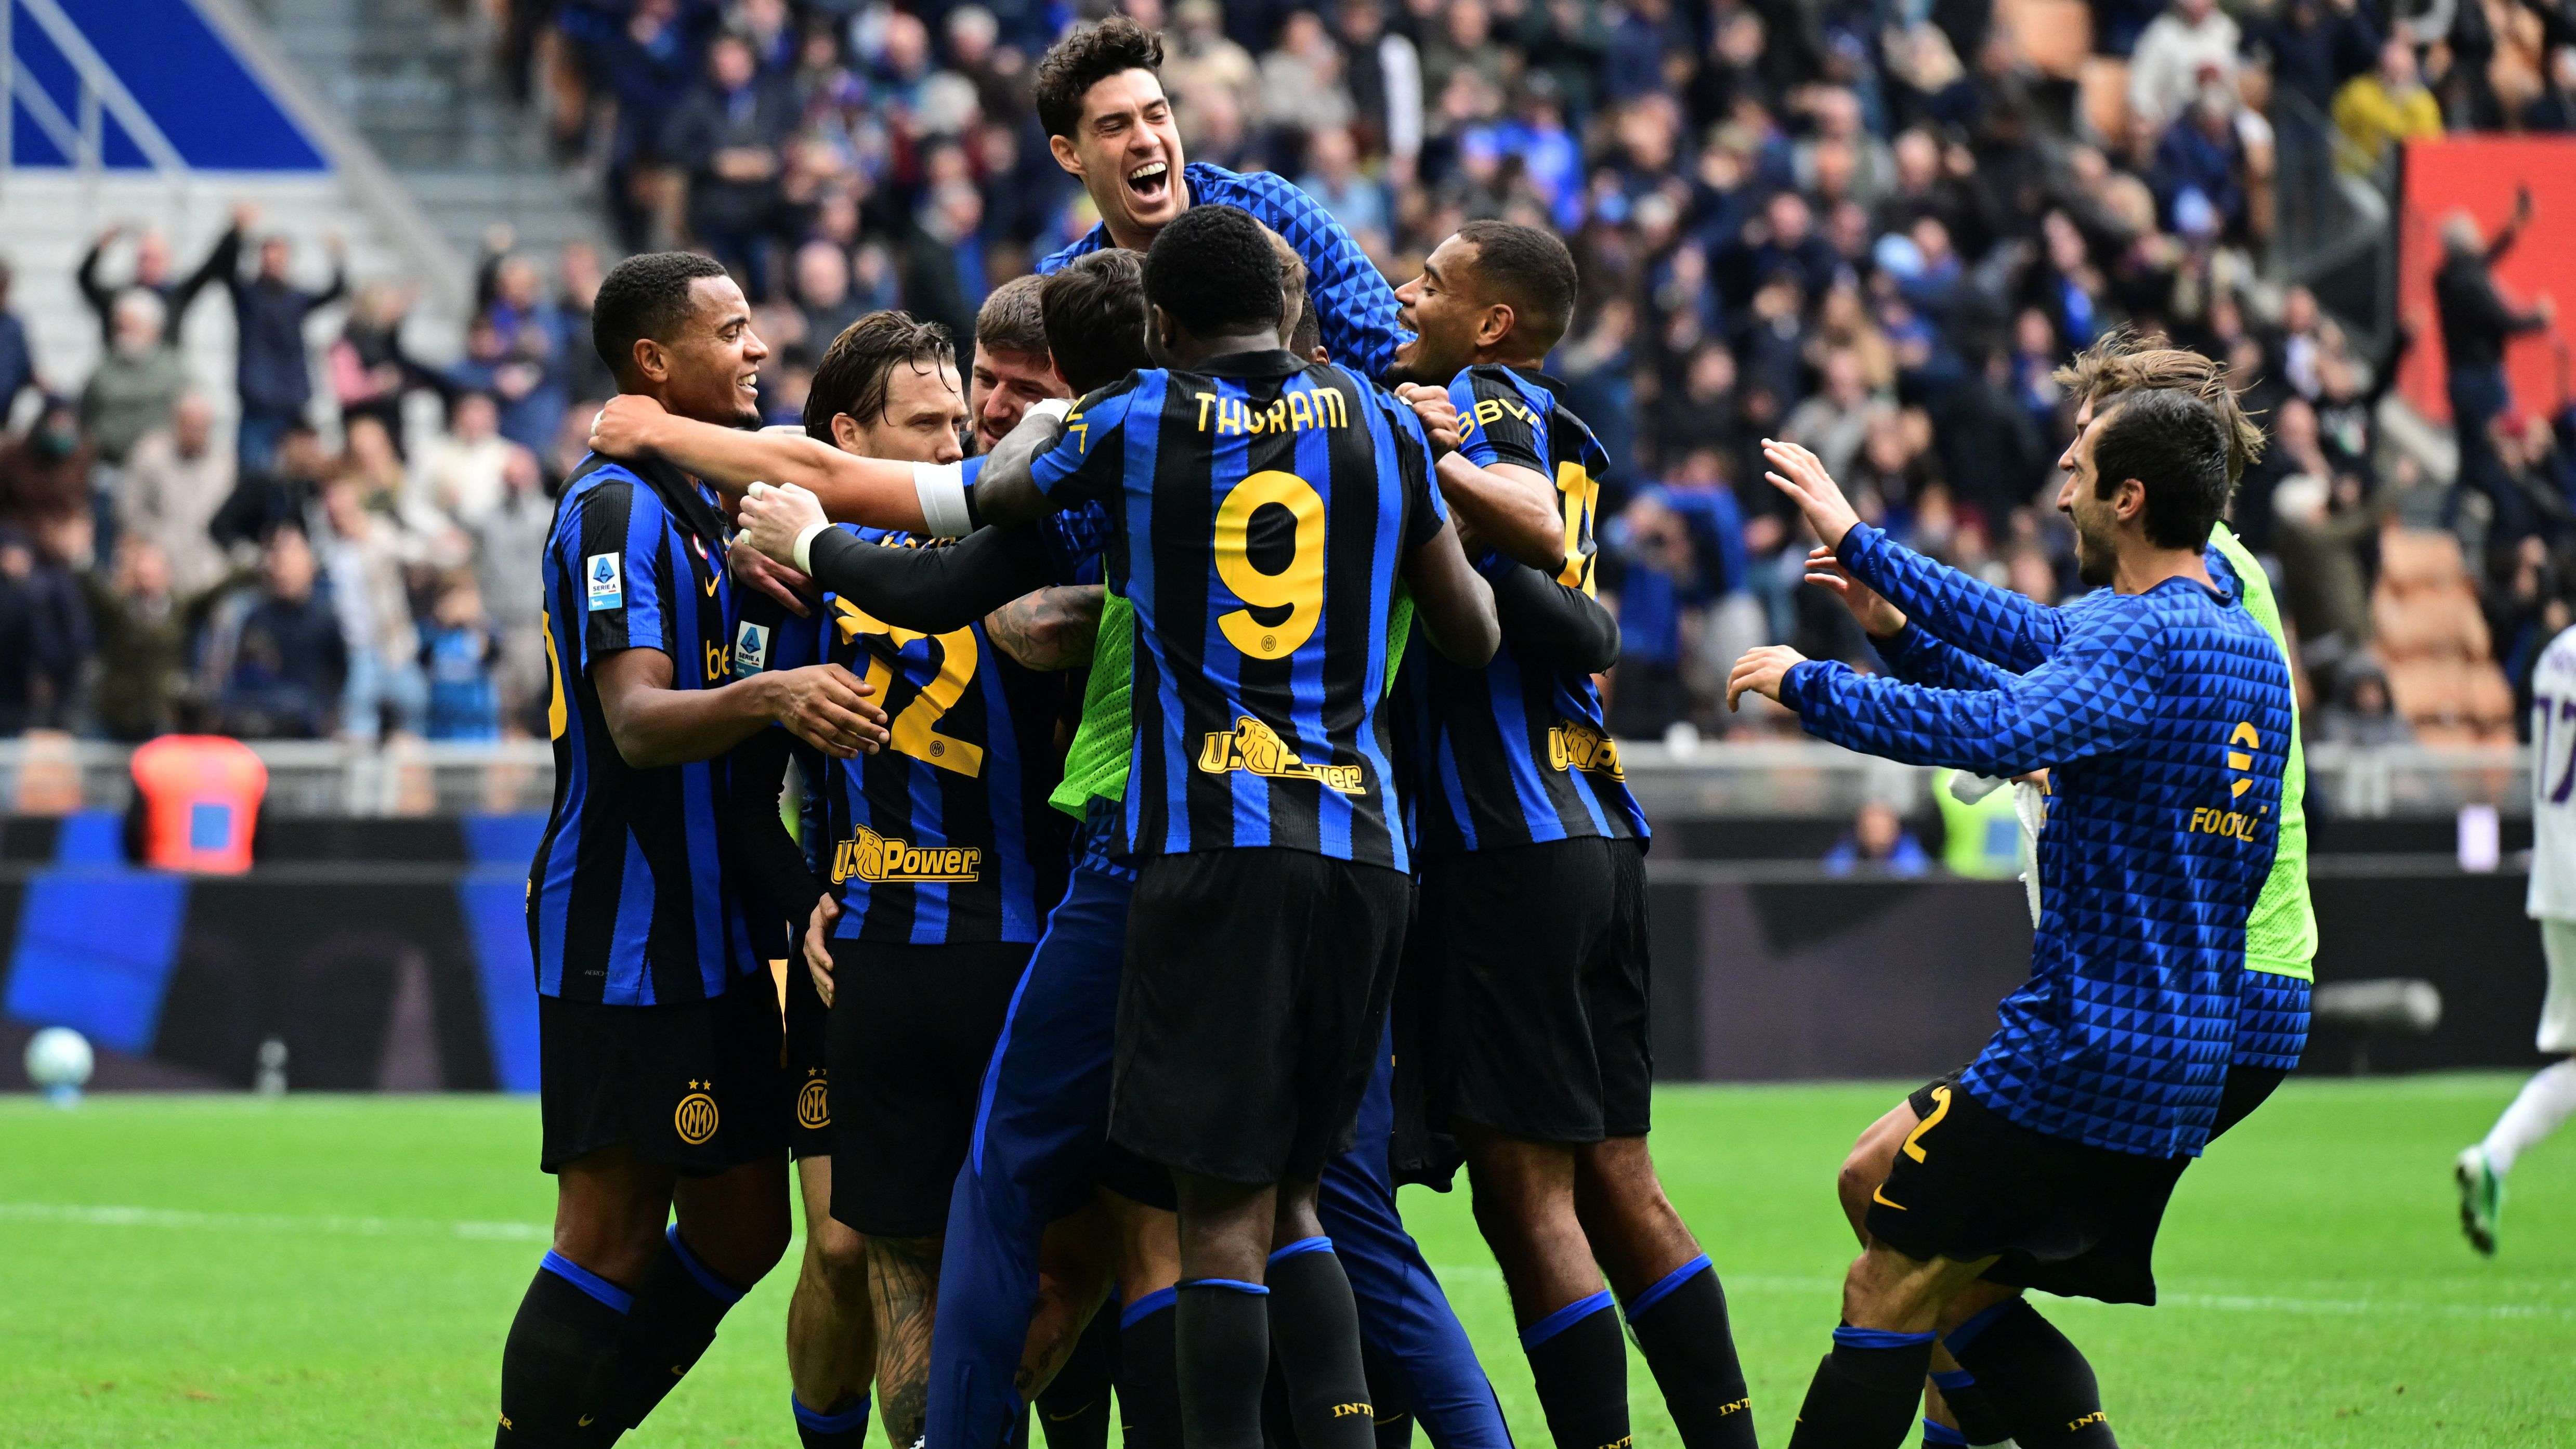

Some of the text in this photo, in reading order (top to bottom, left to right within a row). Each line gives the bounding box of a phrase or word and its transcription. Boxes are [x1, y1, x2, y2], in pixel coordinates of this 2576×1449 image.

[1195, 387, 1348, 435] THURAM
[1214, 470, 1325, 660] 9
[738, 652, 754, 661] SERIE
[1718, 1398, 1750, 1416] INT
[2068, 1412, 2107, 1432] INT
